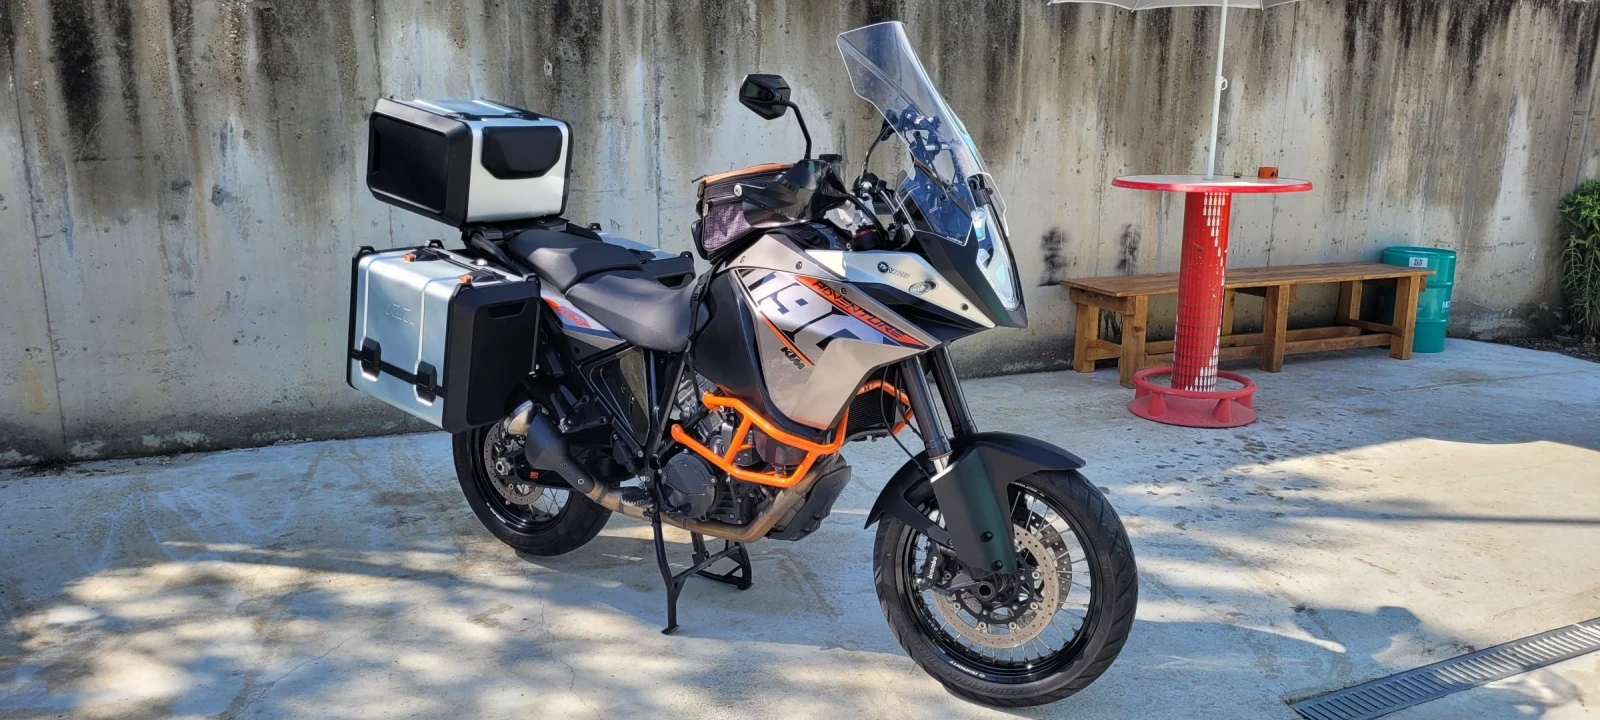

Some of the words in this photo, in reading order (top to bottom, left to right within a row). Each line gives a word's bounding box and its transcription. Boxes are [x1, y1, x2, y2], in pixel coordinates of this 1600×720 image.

[812, 279, 904, 338] ADVENTURE
[780, 346, 806, 370] KTM
[927, 555, 938, 580] brembo
